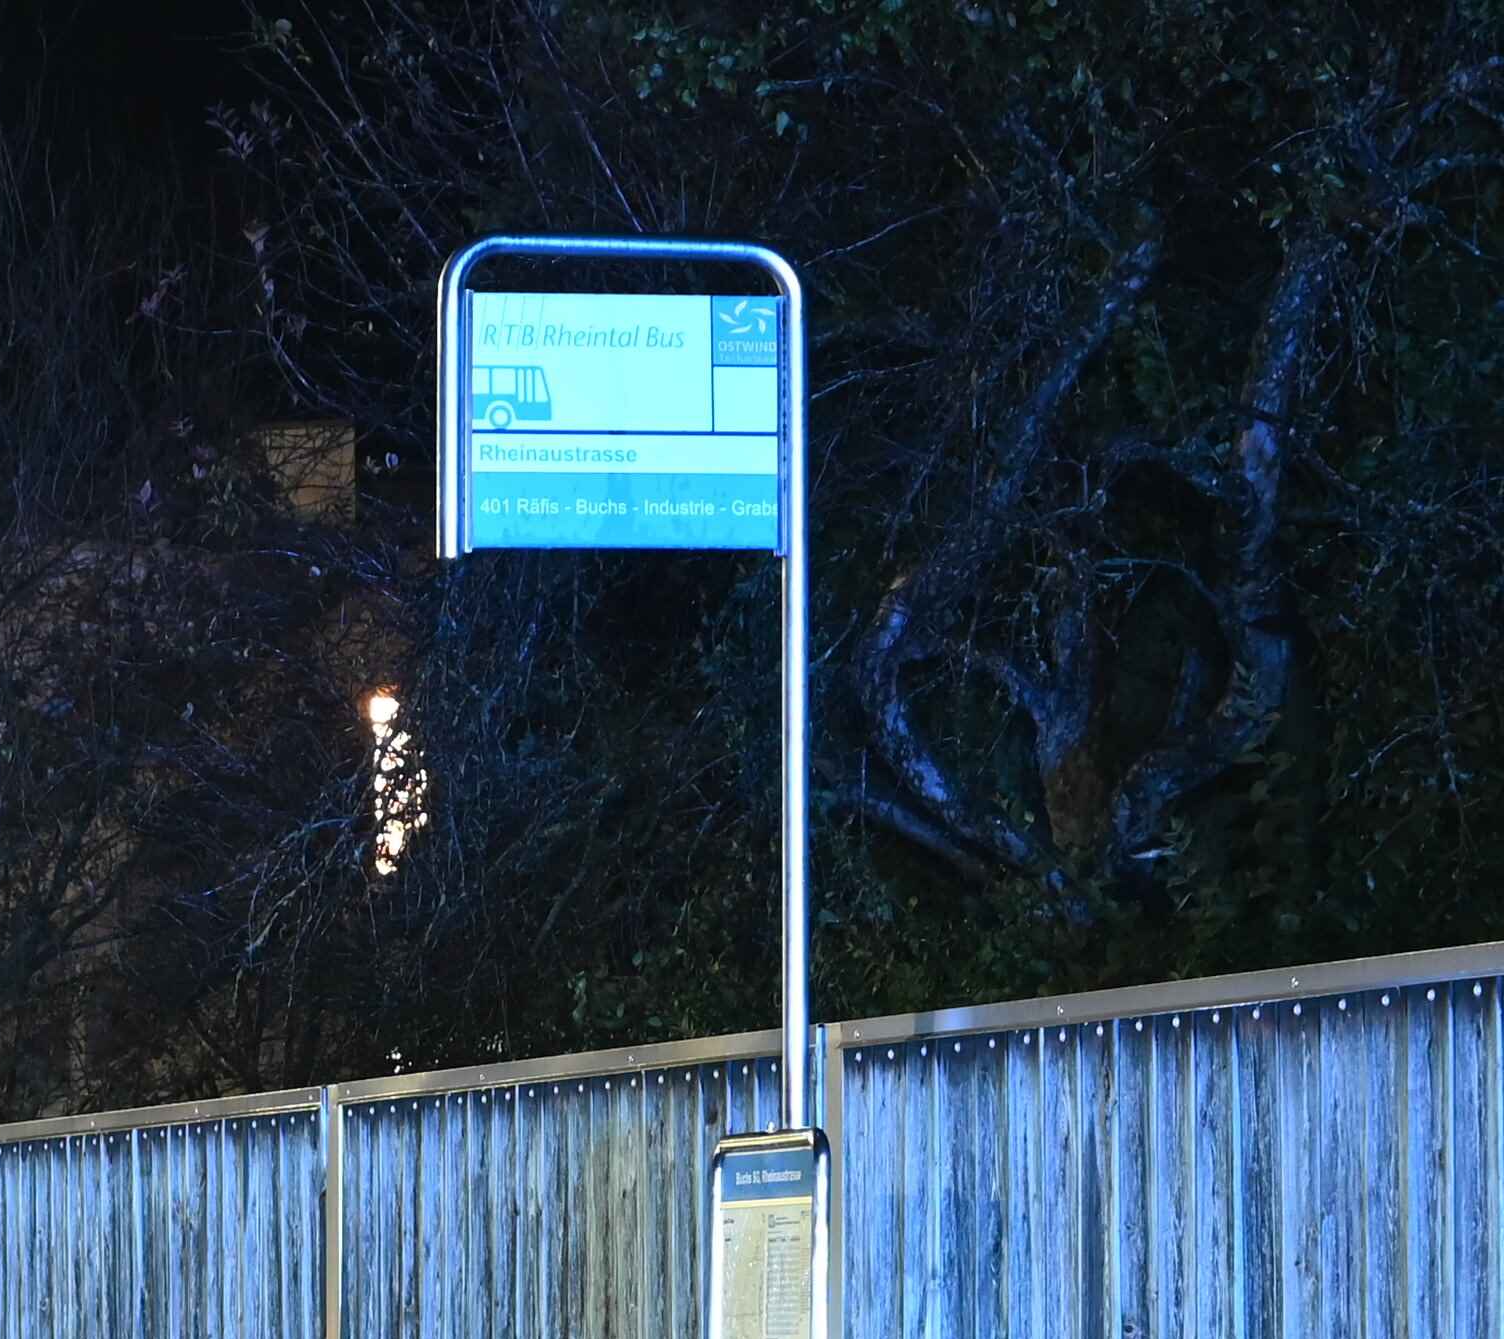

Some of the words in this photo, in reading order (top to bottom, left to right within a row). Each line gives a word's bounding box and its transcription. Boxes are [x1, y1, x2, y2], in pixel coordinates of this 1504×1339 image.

[543, 323, 640, 348] Rheintal
[645, 325, 686, 348] Bus
[718, 340, 777, 352] OSTWIND
[478, 442, 638, 464] Rheinaustrasse
[479, 498, 510, 514] 401
[516, 498, 559, 515] Räfis
[575, 498, 627, 515] Buchs
[644, 499, 715, 516] Industrie
